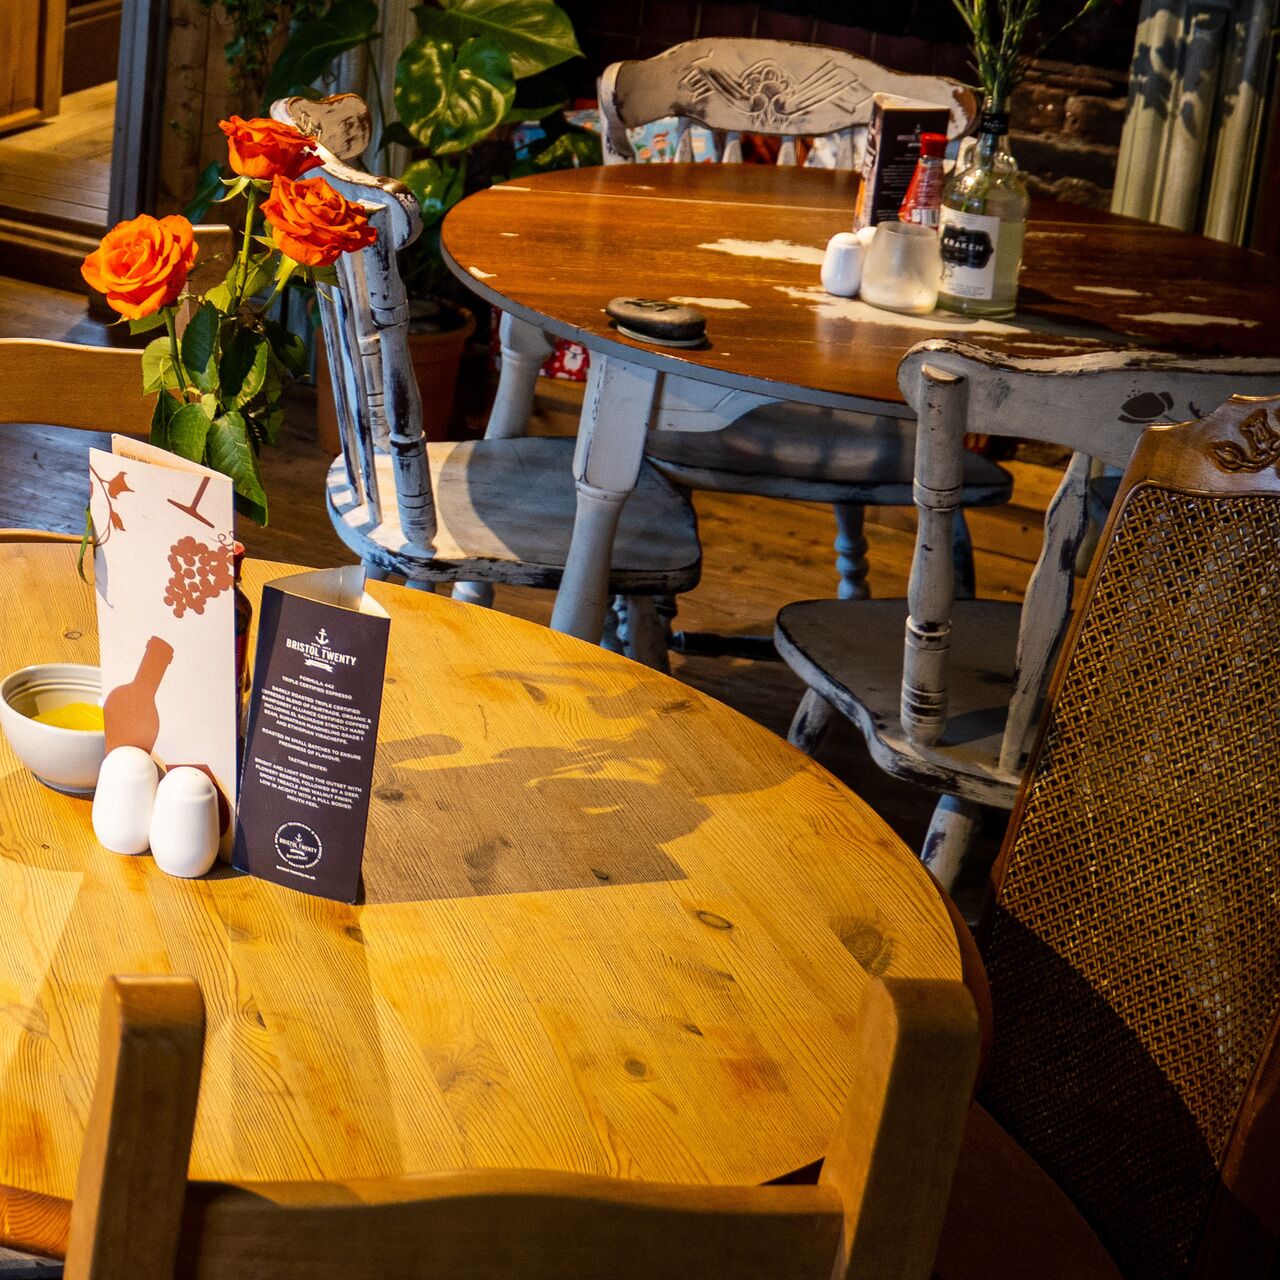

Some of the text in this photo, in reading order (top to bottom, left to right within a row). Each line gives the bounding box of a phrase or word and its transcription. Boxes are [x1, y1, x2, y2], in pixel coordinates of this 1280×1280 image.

[943, 237, 984, 251] KRAKEN
[286, 638, 319, 657] BRISTOL
[321, 649, 356, 666] TWENTY
[281, 675, 352, 700] TRIPLE CERTIFIED ESPRESSO
[299, 675, 334, 689] FORMULA 442
[271, 685, 360, 714] DARKLY ROASTED TRIPLE CERTIFIED
[262, 695, 369, 730] RAINFOREST ALLIANCE CERTIFIED COFFEES
[286, 697, 302, 705] BLEND
[341, 713, 366, 722] ORGANIC
[325, 721, 349, 732] STRICTLY
[341, 730, 359, 740] GRADE
[261, 727, 284, 739] ROASTED
[291, 737, 307, 746] SMALL
[308, 743, 331, 754] BATCHES
[340, 751, 361, 760] ENSURE
[278, 740, 306, 753] FRESHNESS
[287, 755, 308, 766] TASTING
[299, 772, 314, 781] FROM
[326, 780, 347, 789] OUTSET
[301, 780, 330, 792] FOLLOWED
